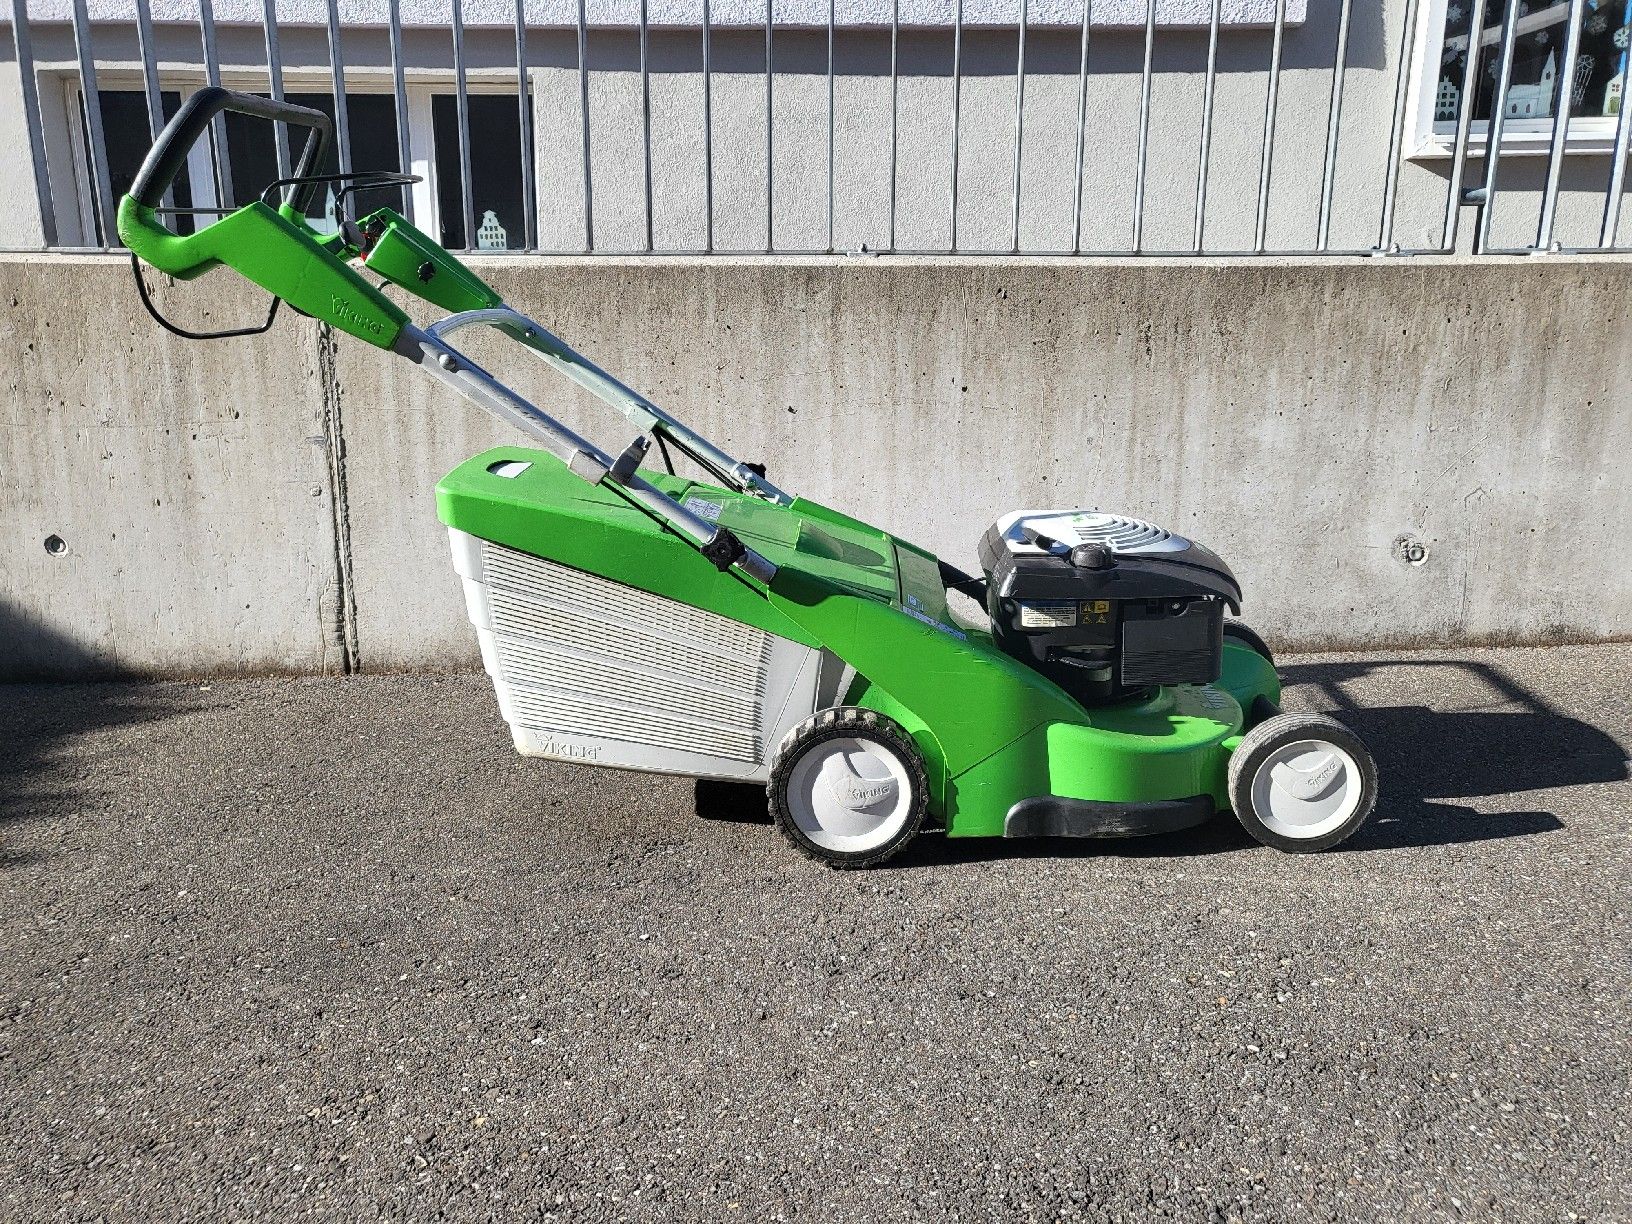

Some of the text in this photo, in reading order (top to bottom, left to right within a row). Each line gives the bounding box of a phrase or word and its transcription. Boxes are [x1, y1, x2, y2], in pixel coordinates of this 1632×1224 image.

[537, 736, 599, 759] VIKING
[1306, 761, 1338, 788] VIKING
[853, 785, 890, 800] VIKING
